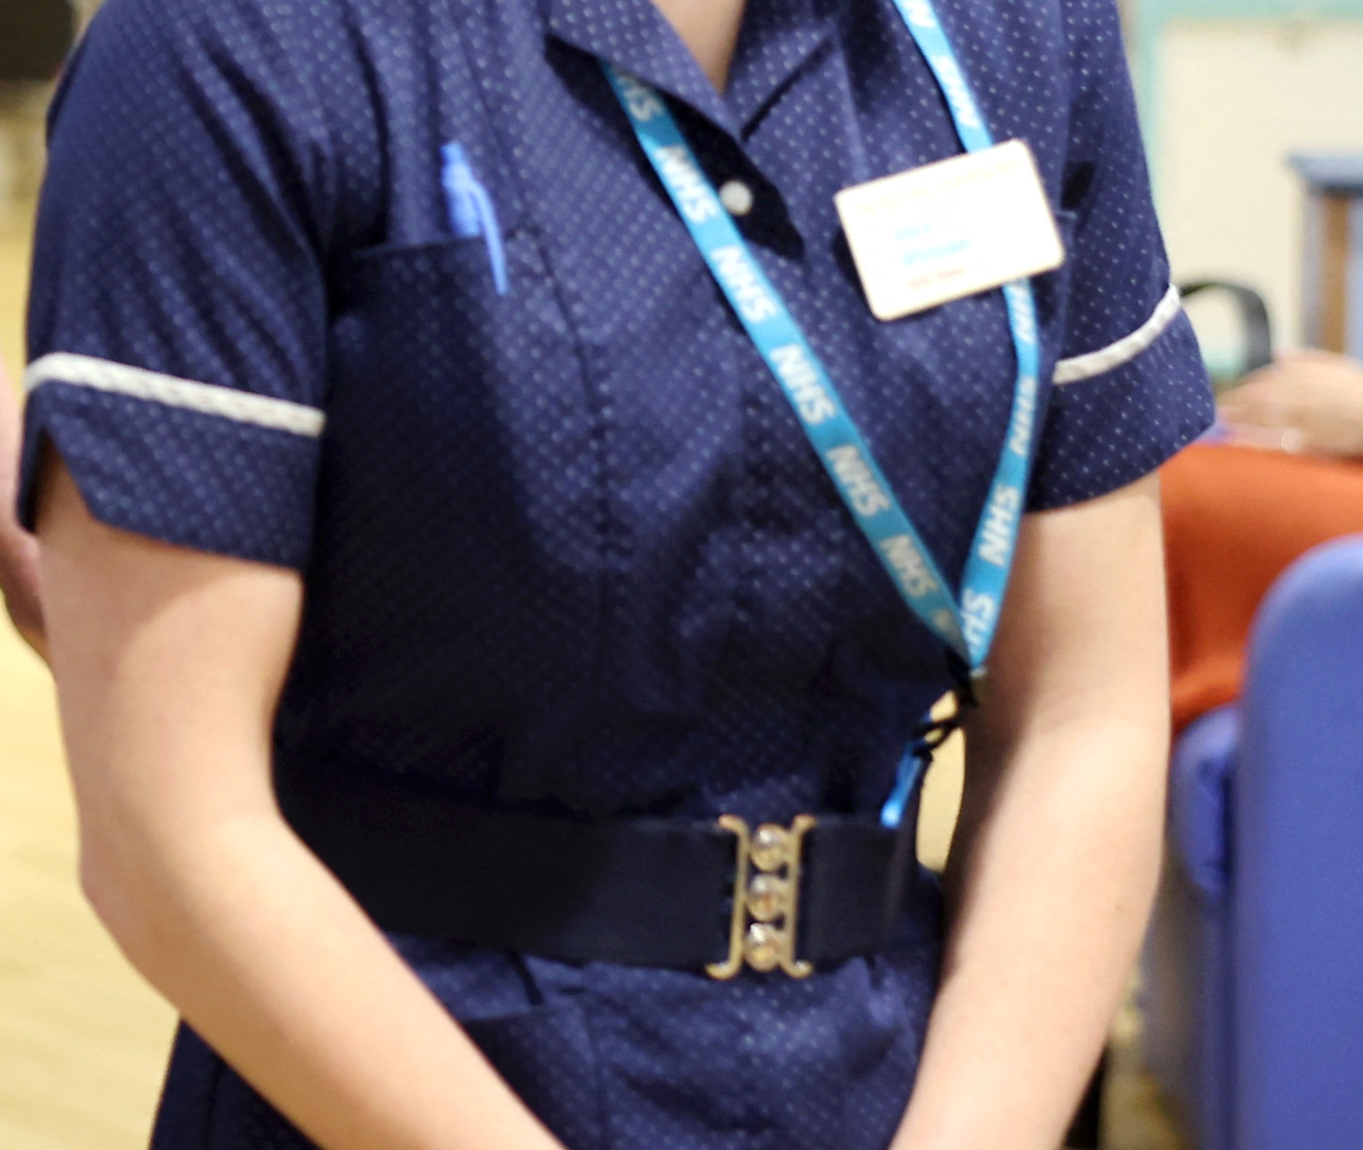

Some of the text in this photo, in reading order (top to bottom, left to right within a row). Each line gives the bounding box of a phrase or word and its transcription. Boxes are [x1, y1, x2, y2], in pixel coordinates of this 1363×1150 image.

[1007, 282, 1035, 344] NH
[656, 145, 715, 223] NHS
[710, 245, 776, 324] NHS
[769, 344, 835, 425] NHS
[825, 444, 891, 519] NHS
[879, 534, 940, 599] NHS
[978, 484, 1019, 568] NHS
[961, 587, 995, 652] HS
